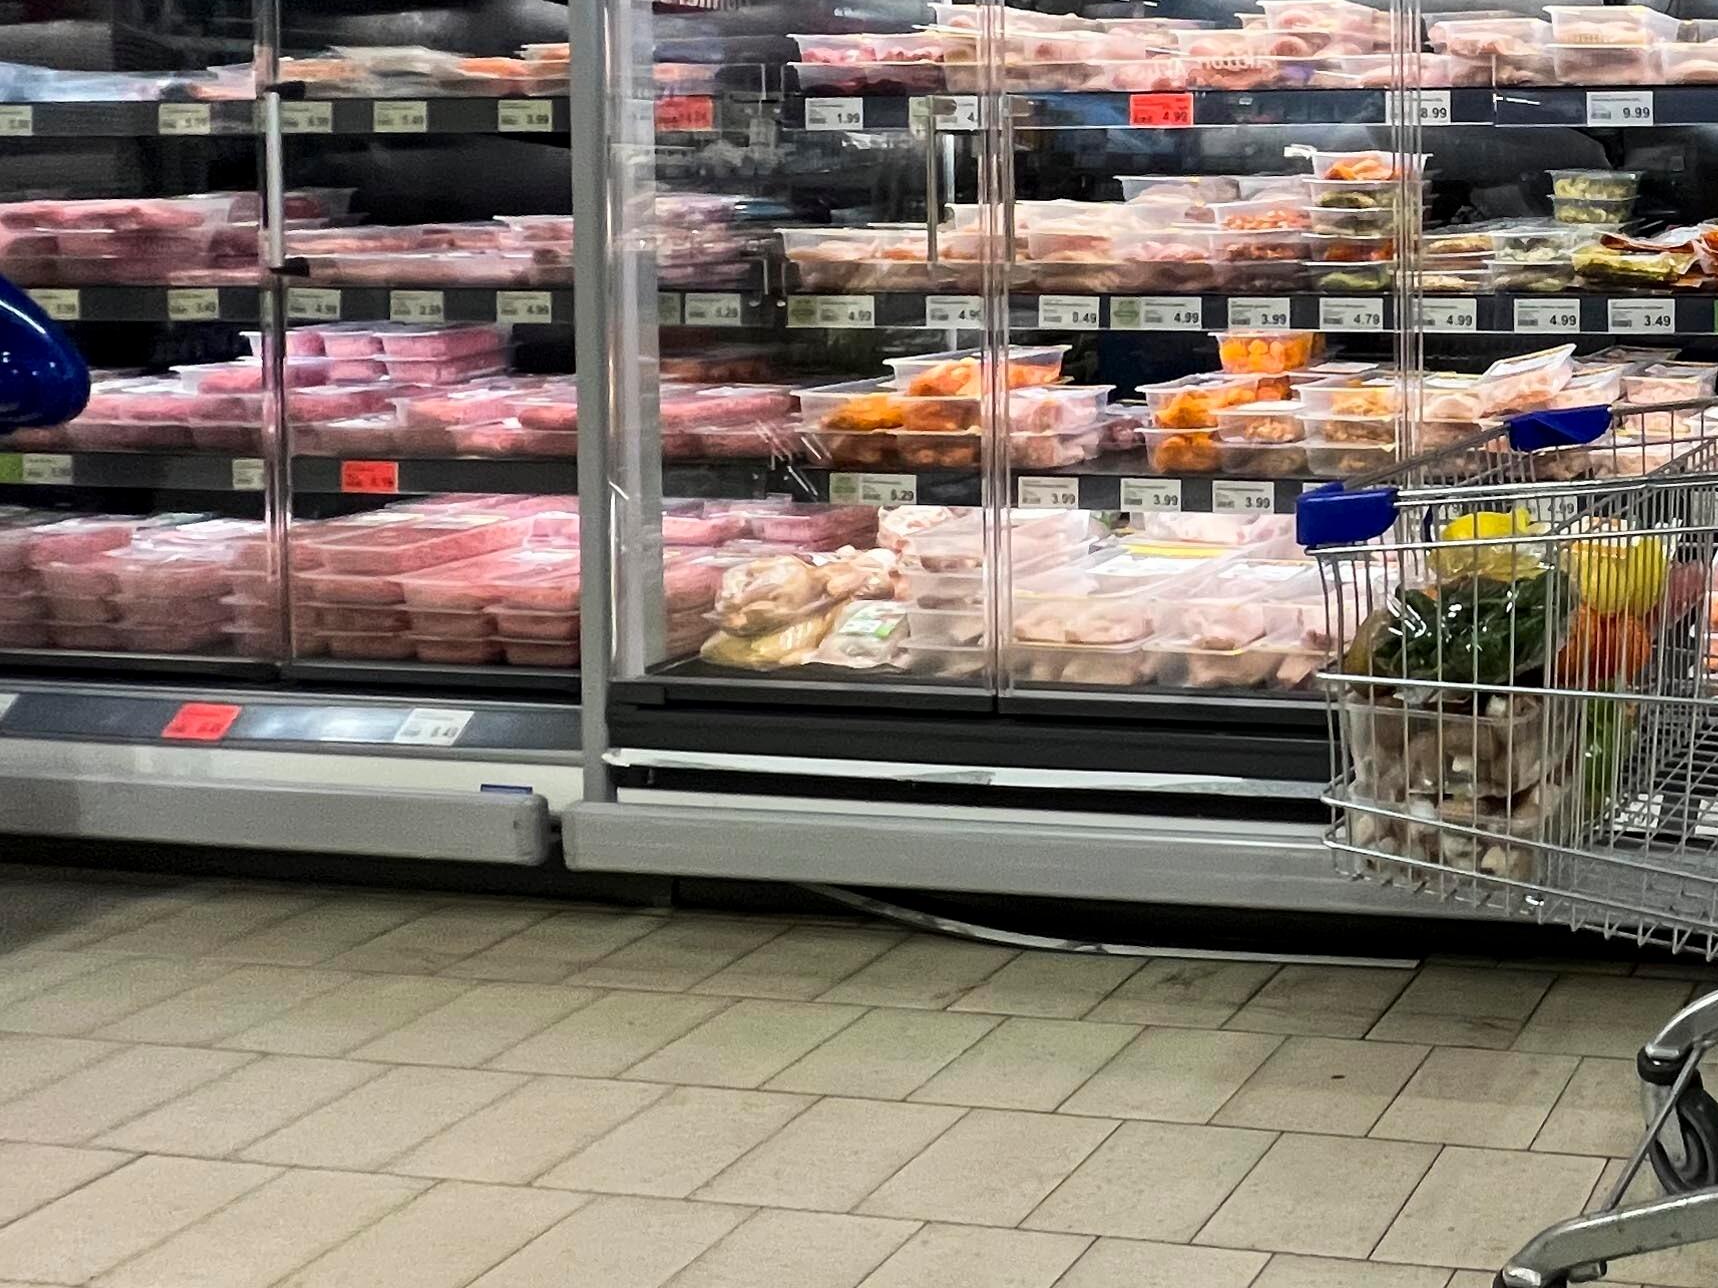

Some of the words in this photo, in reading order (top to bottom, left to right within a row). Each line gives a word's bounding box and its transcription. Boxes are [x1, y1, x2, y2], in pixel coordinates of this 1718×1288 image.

[1623, 107, 1650, 118] 9.99
[838, 113, 860, 124] 1.99
[1174, 312, 1199, 323] 4.99
[1261, 313, 1287, 325] 3.99
[1353, 313, 1380, 325] 4.79
[1446, 314, 1473, 326] 4.99
[1549, 314, 1577, 326] 4.99
[1644, 315, 1671, 326] 3.49
[1153, 494, 1178, 506] 3.99
[1245, 497, 1270, 508] 3.99
